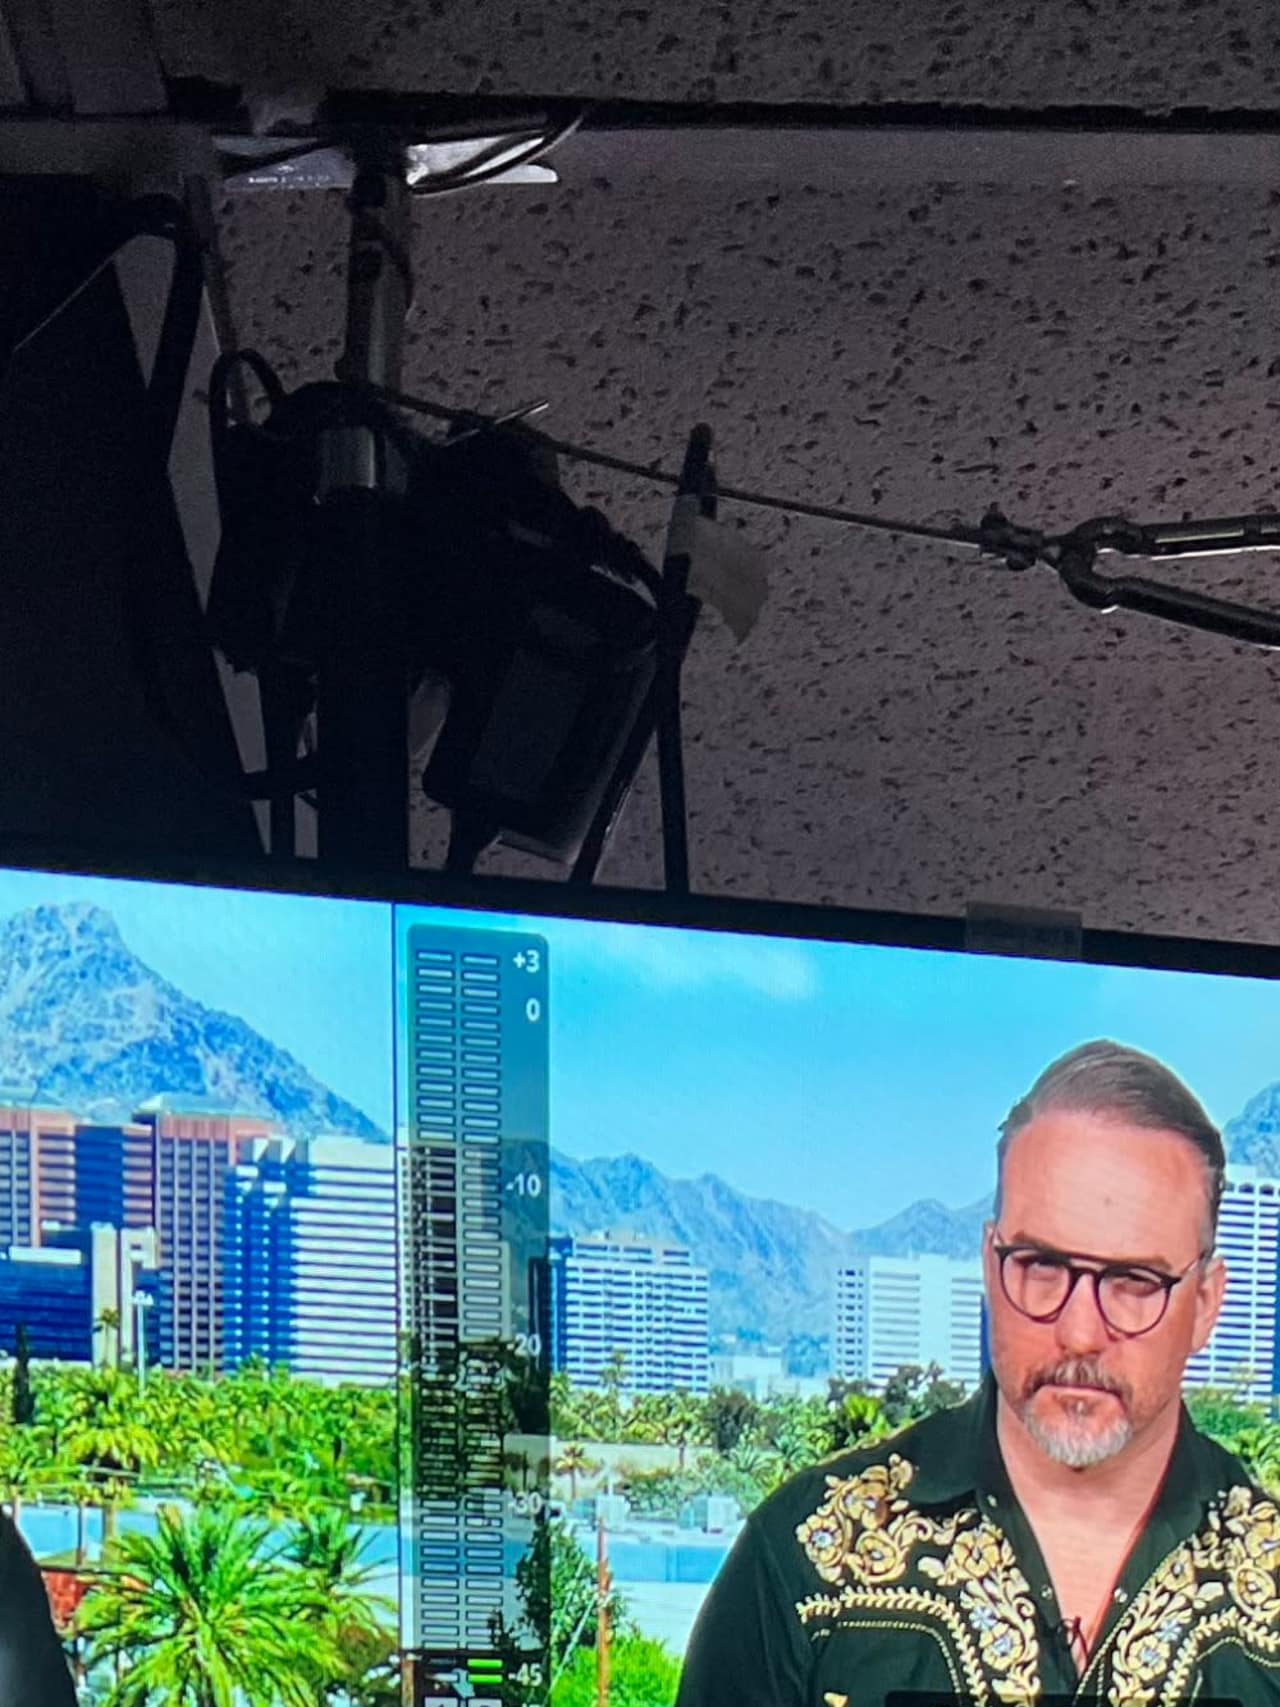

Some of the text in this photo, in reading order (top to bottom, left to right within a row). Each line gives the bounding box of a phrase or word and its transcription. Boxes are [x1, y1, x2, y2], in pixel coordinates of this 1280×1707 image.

[512, 951, 540, 973] +3
[526, 998, 540, 1022] 0
[506, 1173, 541, 1196] -10
[507, 1334, 541, 1356] -20
[508, 1663, 542, 1687] -45
